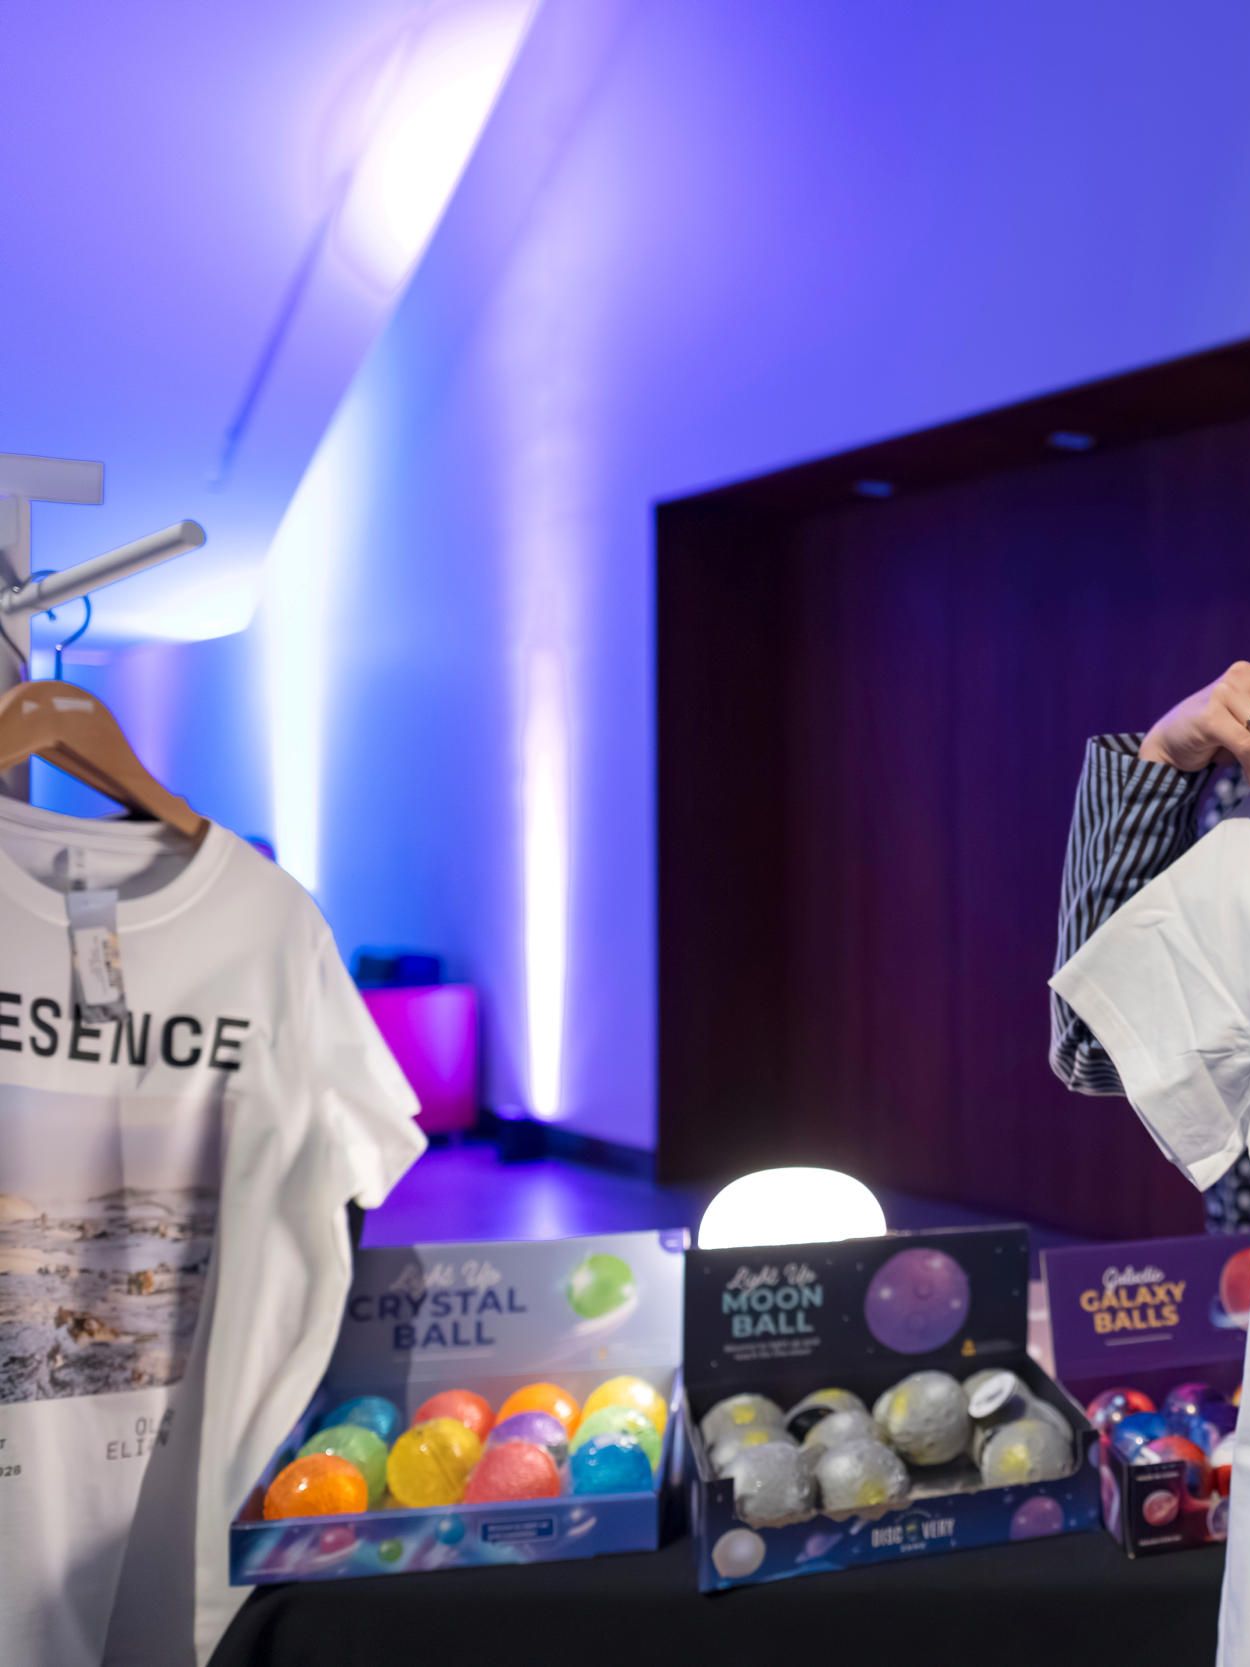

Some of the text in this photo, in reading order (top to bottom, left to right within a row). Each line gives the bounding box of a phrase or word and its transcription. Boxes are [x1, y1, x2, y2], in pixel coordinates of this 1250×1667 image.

[349, 1286, 527, 1322] CRYSTAL
[722, 1284, 824, 1314] MOON
[1079, 1280, 1187, 1312] GALAXY
[393, 1319, 496, 1350] BALL
[732, 1310, 815, 1338] BALL
[1093, 1304, 1180, 1335] BALLS
